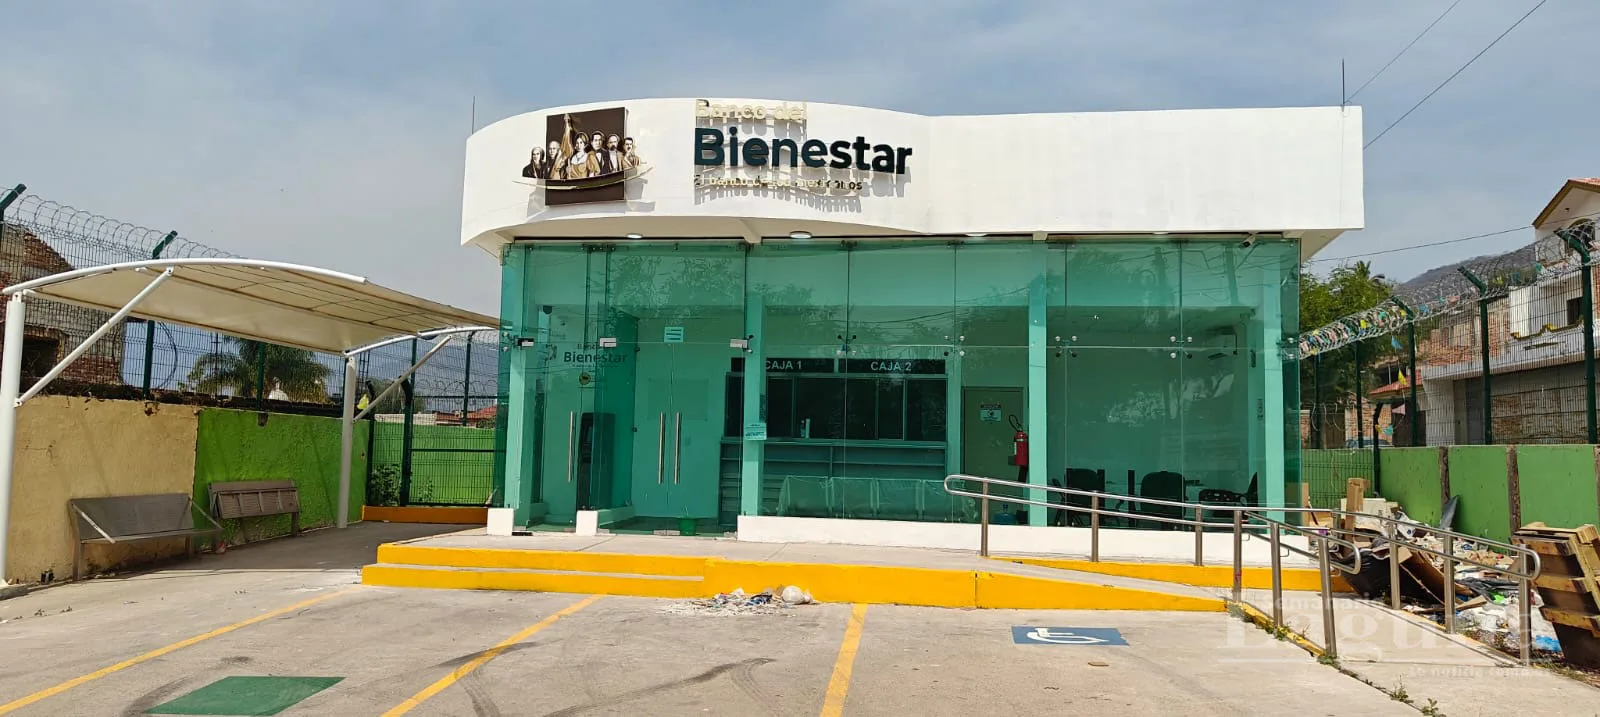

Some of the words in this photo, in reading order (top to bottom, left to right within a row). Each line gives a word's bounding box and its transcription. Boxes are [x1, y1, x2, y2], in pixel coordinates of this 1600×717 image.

[695, 99, 767, 119] Banco
[774, 101, 808, 121] del
[694, 126, 913, 175] Bienestar
[563, 351, 628, 363] Bienestar
[764, 360, 794, 370] CAJA
[797, 361, 803, 370] 1
[870, 361, 902, 371] CAJA
[904, 362, 912, 371] 2
